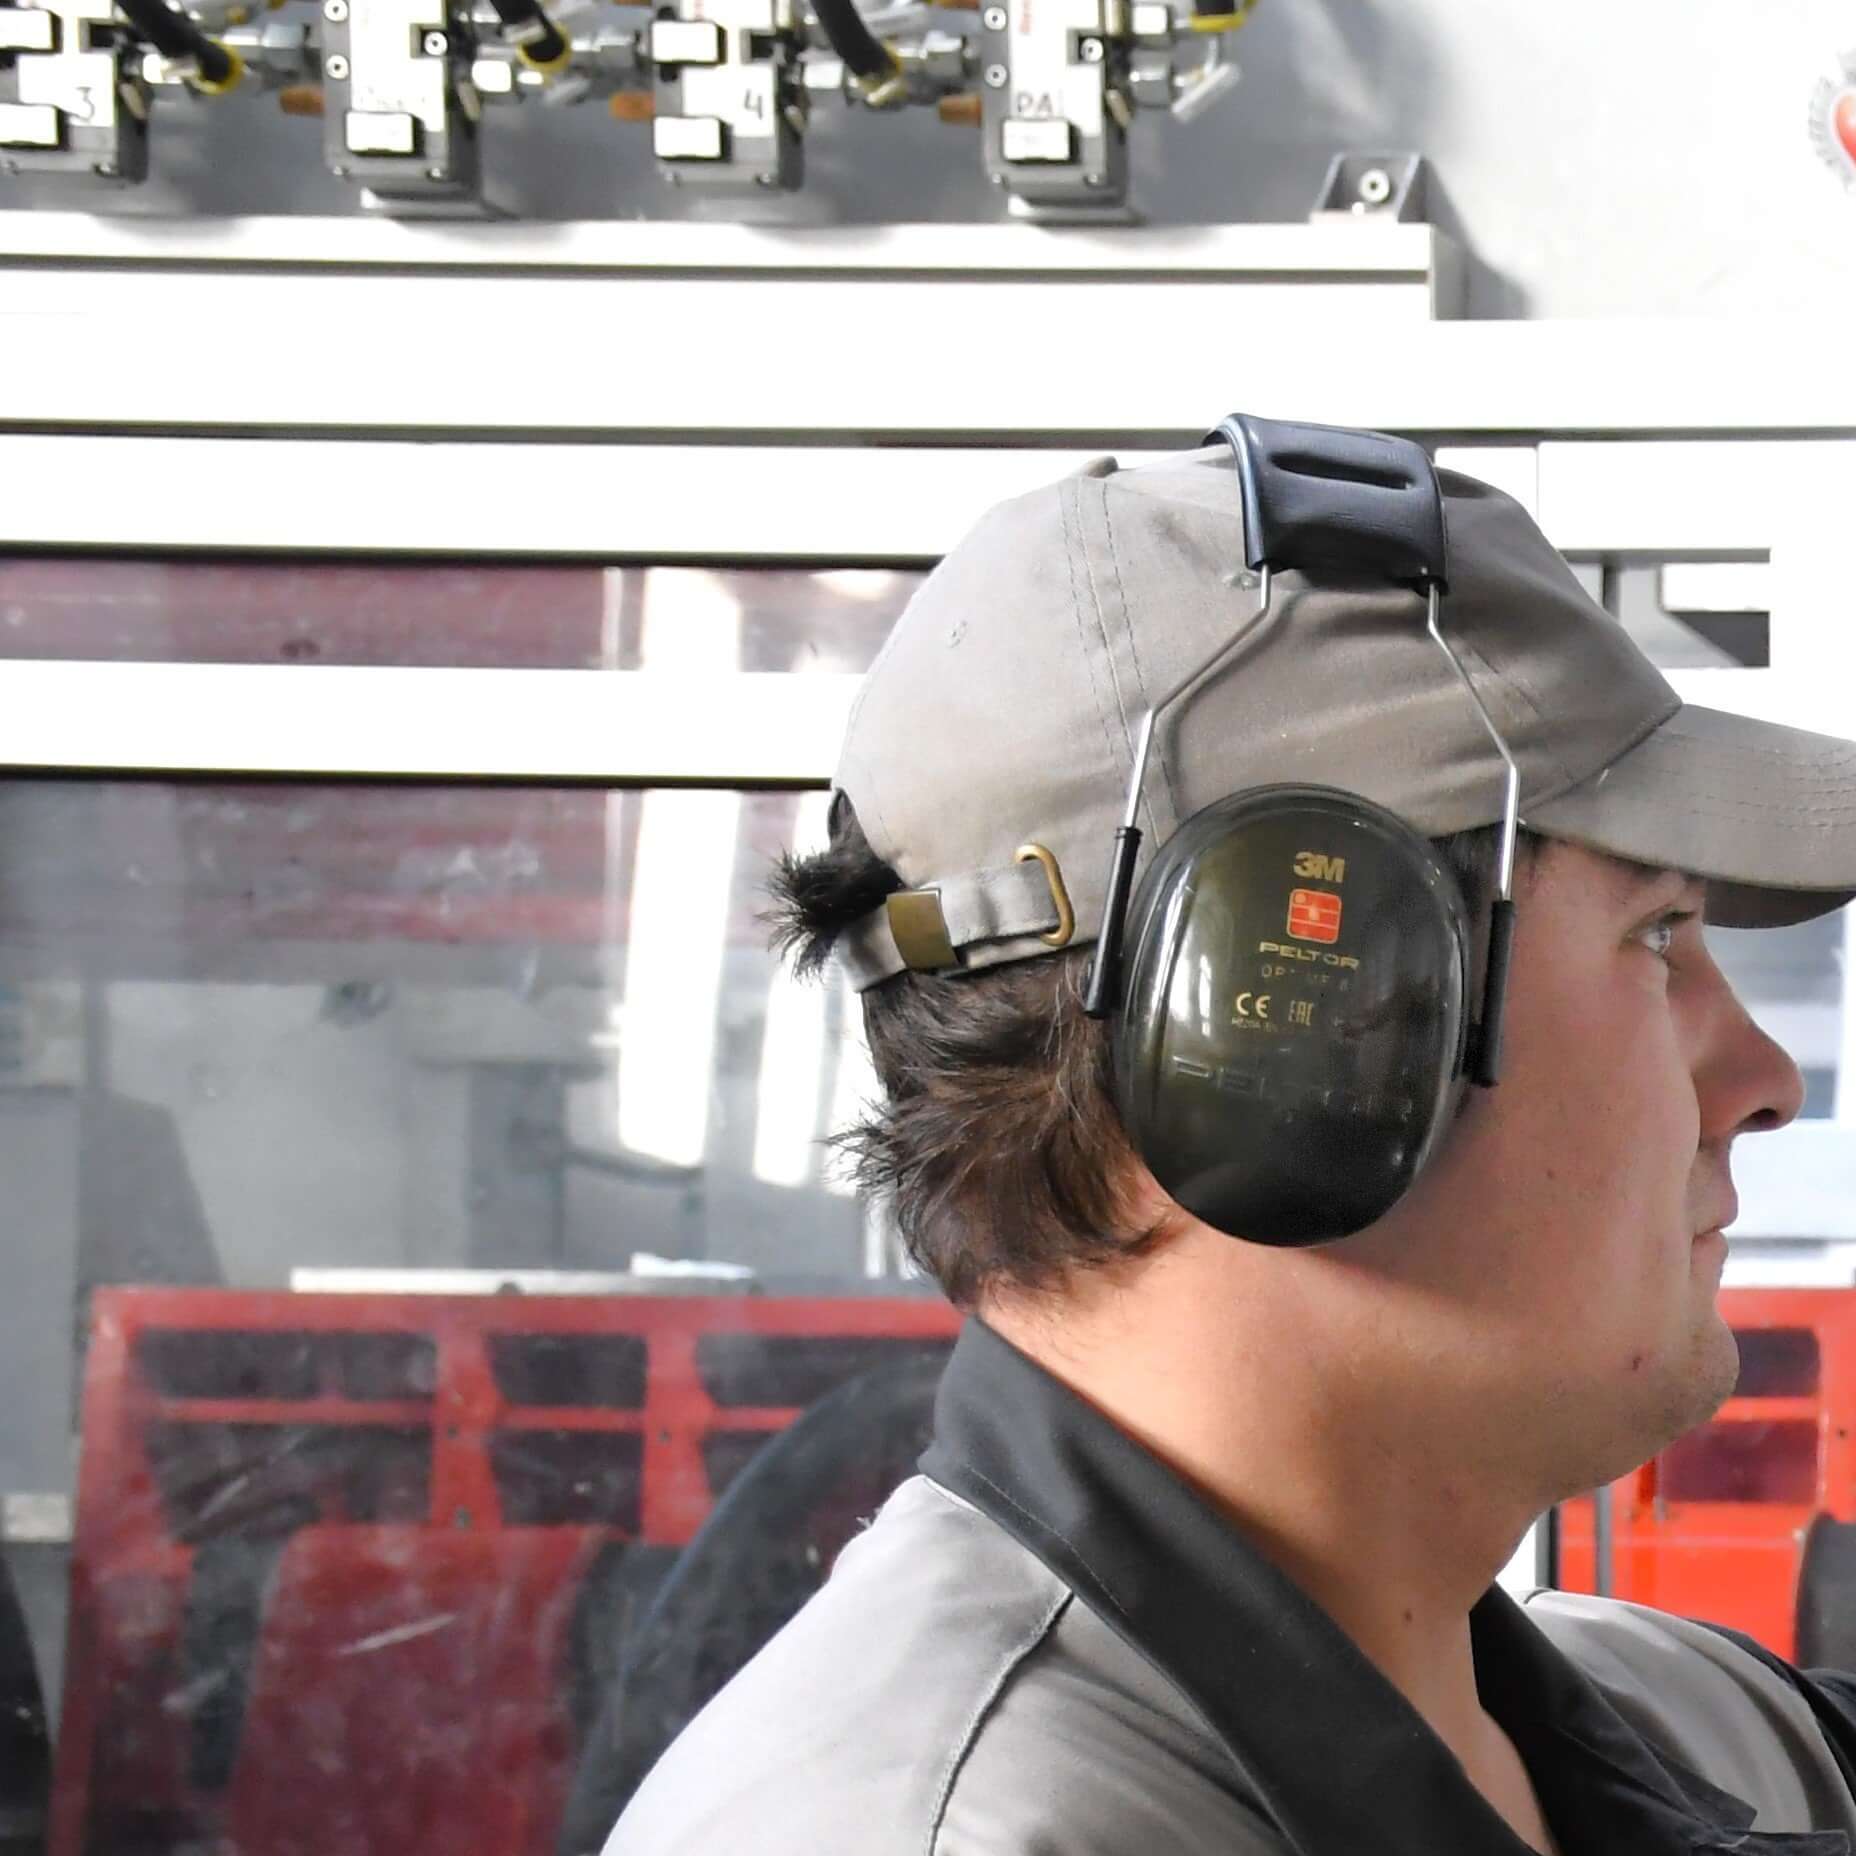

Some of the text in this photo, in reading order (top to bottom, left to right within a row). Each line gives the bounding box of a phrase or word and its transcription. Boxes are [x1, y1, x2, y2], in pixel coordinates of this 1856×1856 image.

[1293, 852, 1345, 883] 3M
[1259, 941, 1360, 971] PELTOR
[1236, 992, 1271, 1018] CE
